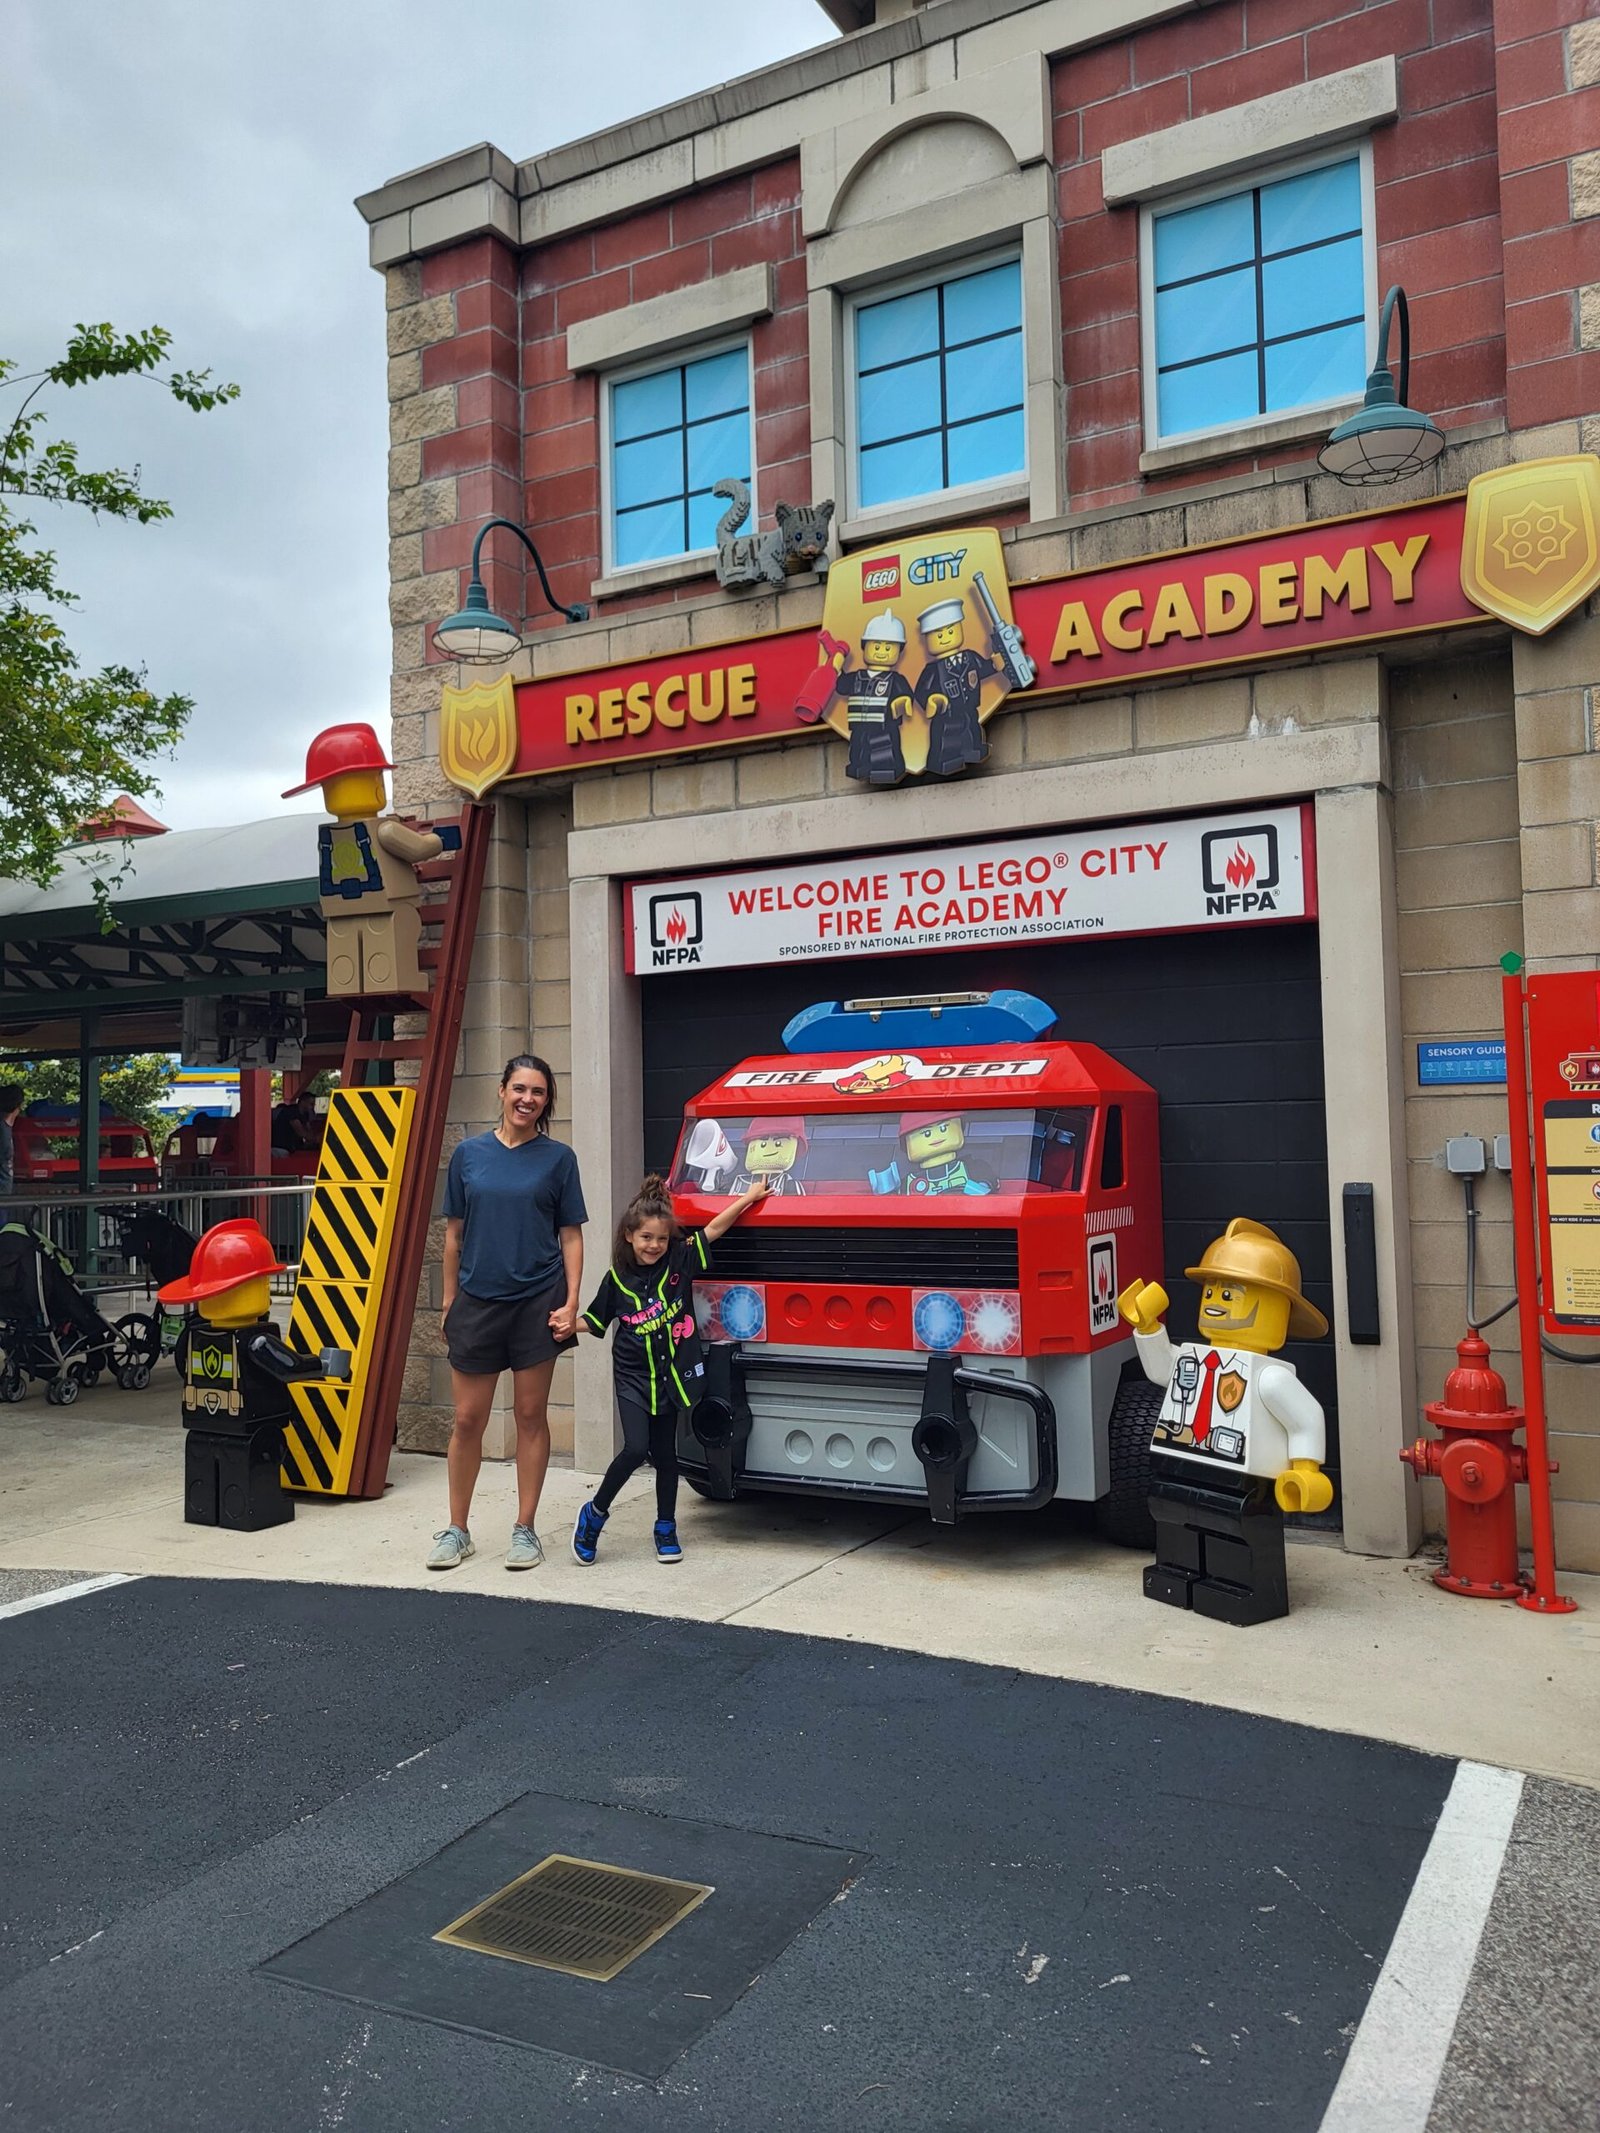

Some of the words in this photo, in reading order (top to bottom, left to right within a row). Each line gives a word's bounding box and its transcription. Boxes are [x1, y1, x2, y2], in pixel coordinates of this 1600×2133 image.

[864, 567, 899, 591] LEGO
[565, 663, 759, 745] RESCUE
[1050, 534, 1431, 663] ACADEMY
[728, 874, 889, 916] WELCOME
[900, 868, 946, 897] TO
[1080, 841, 1169, 878] CITY
[818, 908, 882, 938] FIRE
[894, 887, 1068, 931] ACADEMY
[779, 942, 841, 956] SPONSORED
[844, 940, 857, 952] BY
[860, 934, 915, 949] NATIONAL
[918, 932, 942, 944] FIRE
[944, 925, 1018, 942] PROTECTION
[1021, 917, 1104, 935] ASSOCIATION
[1427, 1047, 1474, 1057] SENSORY
[746, 1071, 822, 1085] FIRE
[931, 1061, 1031, 1079] DEPT
[1093, 1303, 1115, 1327] NFPA
